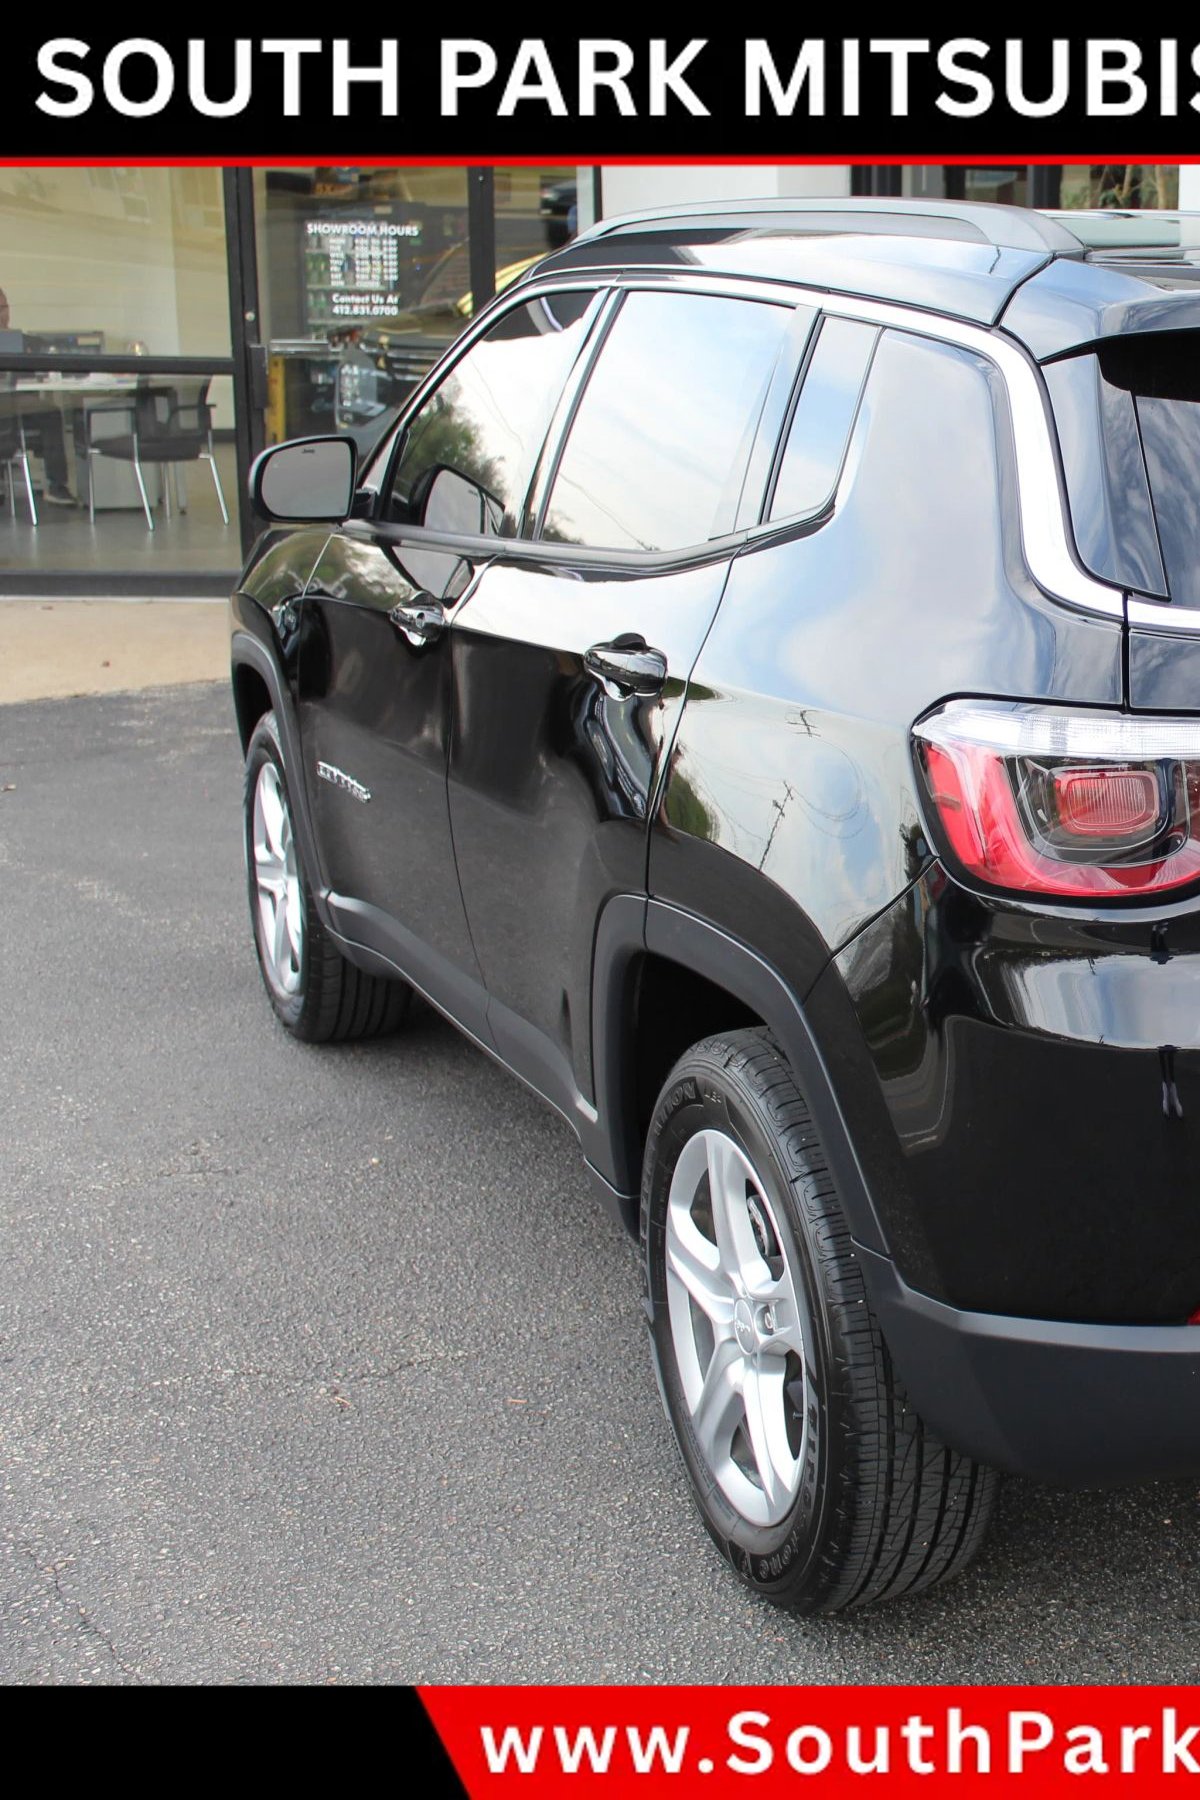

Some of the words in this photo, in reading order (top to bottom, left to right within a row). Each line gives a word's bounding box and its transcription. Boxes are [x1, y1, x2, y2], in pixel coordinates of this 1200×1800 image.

[306, 223, 378, 235] SHOWROOM
[380, 224, 420, 236] HOURS
[332, 294, 370, 304] Contact
[371, 294, 384, 304] Us
[386, 294, 399, 304] At
[332, 305, 399, 315] 412.831.0700
